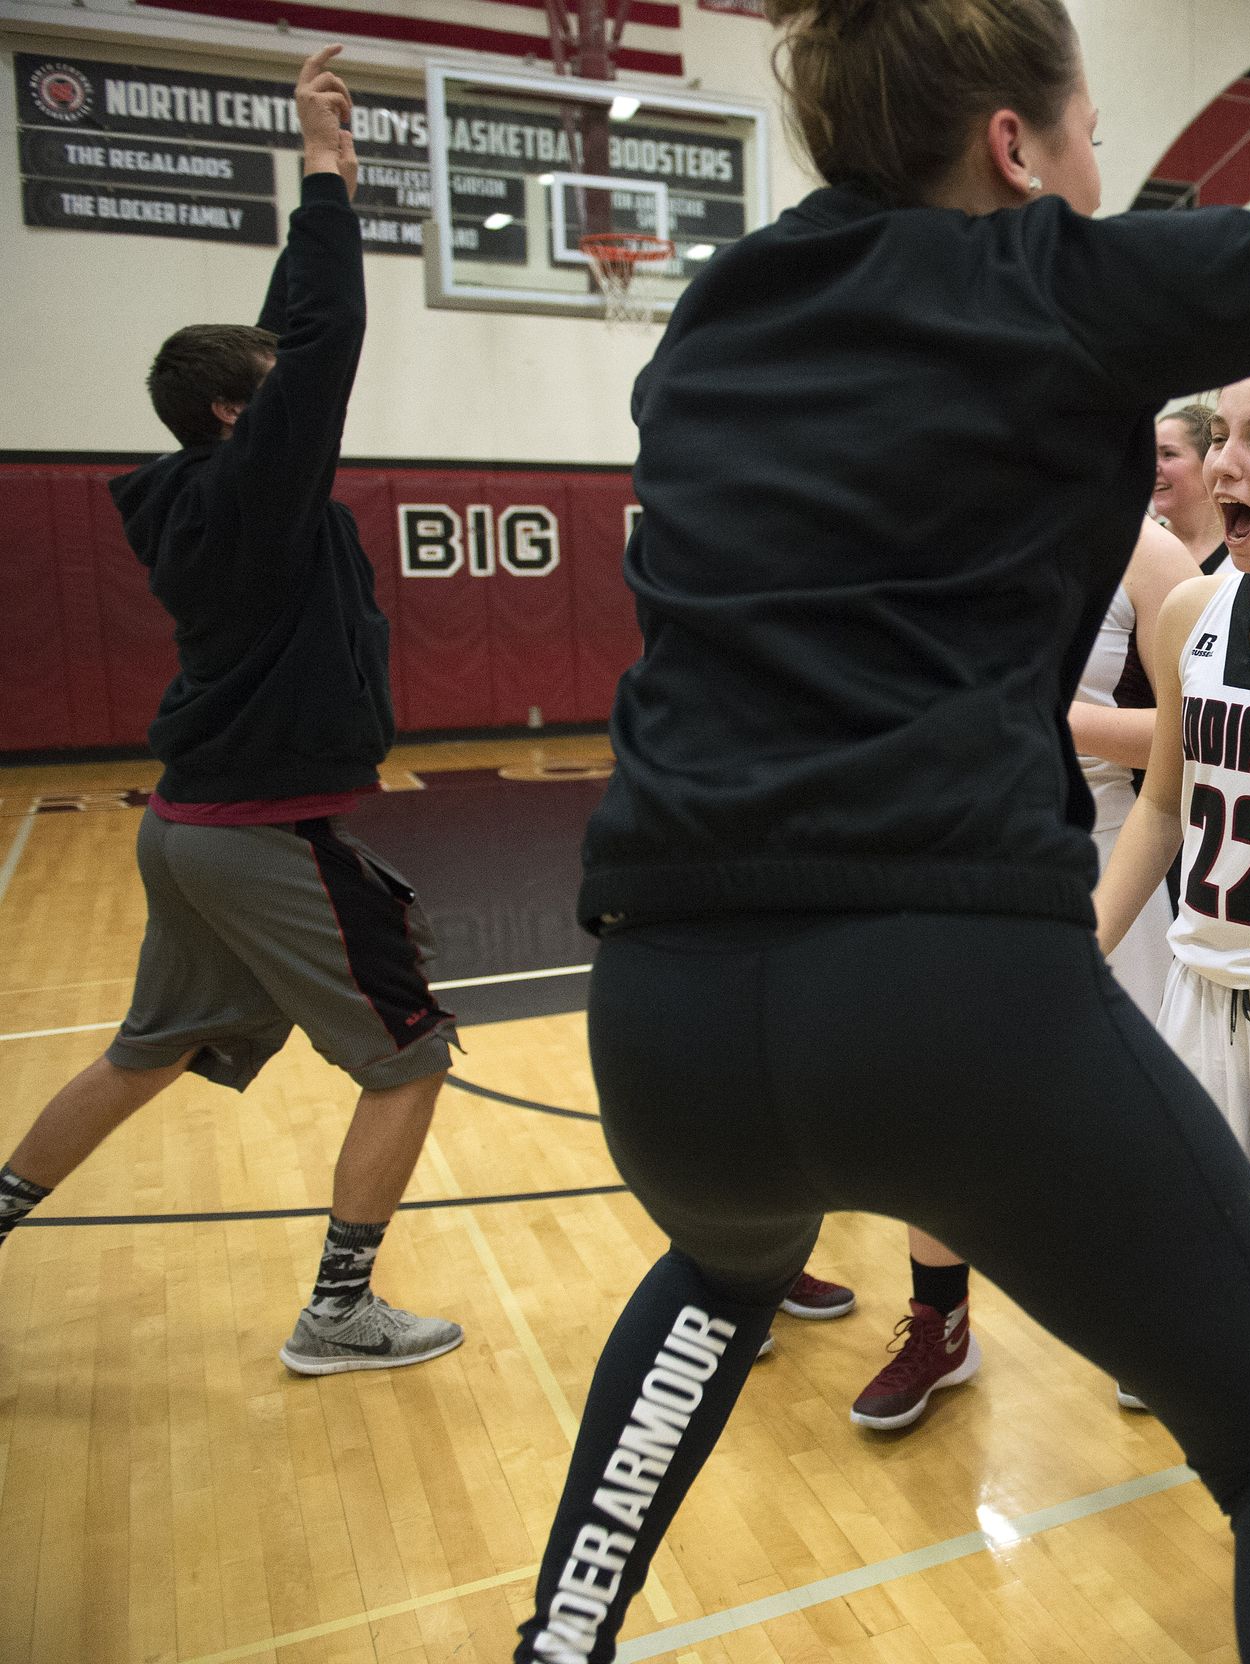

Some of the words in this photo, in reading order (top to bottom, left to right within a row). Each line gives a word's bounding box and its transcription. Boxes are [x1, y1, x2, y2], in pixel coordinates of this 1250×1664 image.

[65, 144, 105, 167] THE
[108, 148, 233, 179] REGALADOS
[104, 78, 212, 125] NORTH
[215, 90, 300, 134] CENT
[353, 106, 430, 147] BOYS
[447, 115, 586, 165] ASKETBAL
[608, 135, 733, 182] BOOSTERS
[61, 192, 97, 216] THE
[97, 196, 176, 225] BLOCKER
[178, 204, 243, 231] FAMILY
[398, 504, 561, 577] BIG
[530, 1521, 637, 1664] NDER
[592, 1304, 738, 1532] ARMOUR
